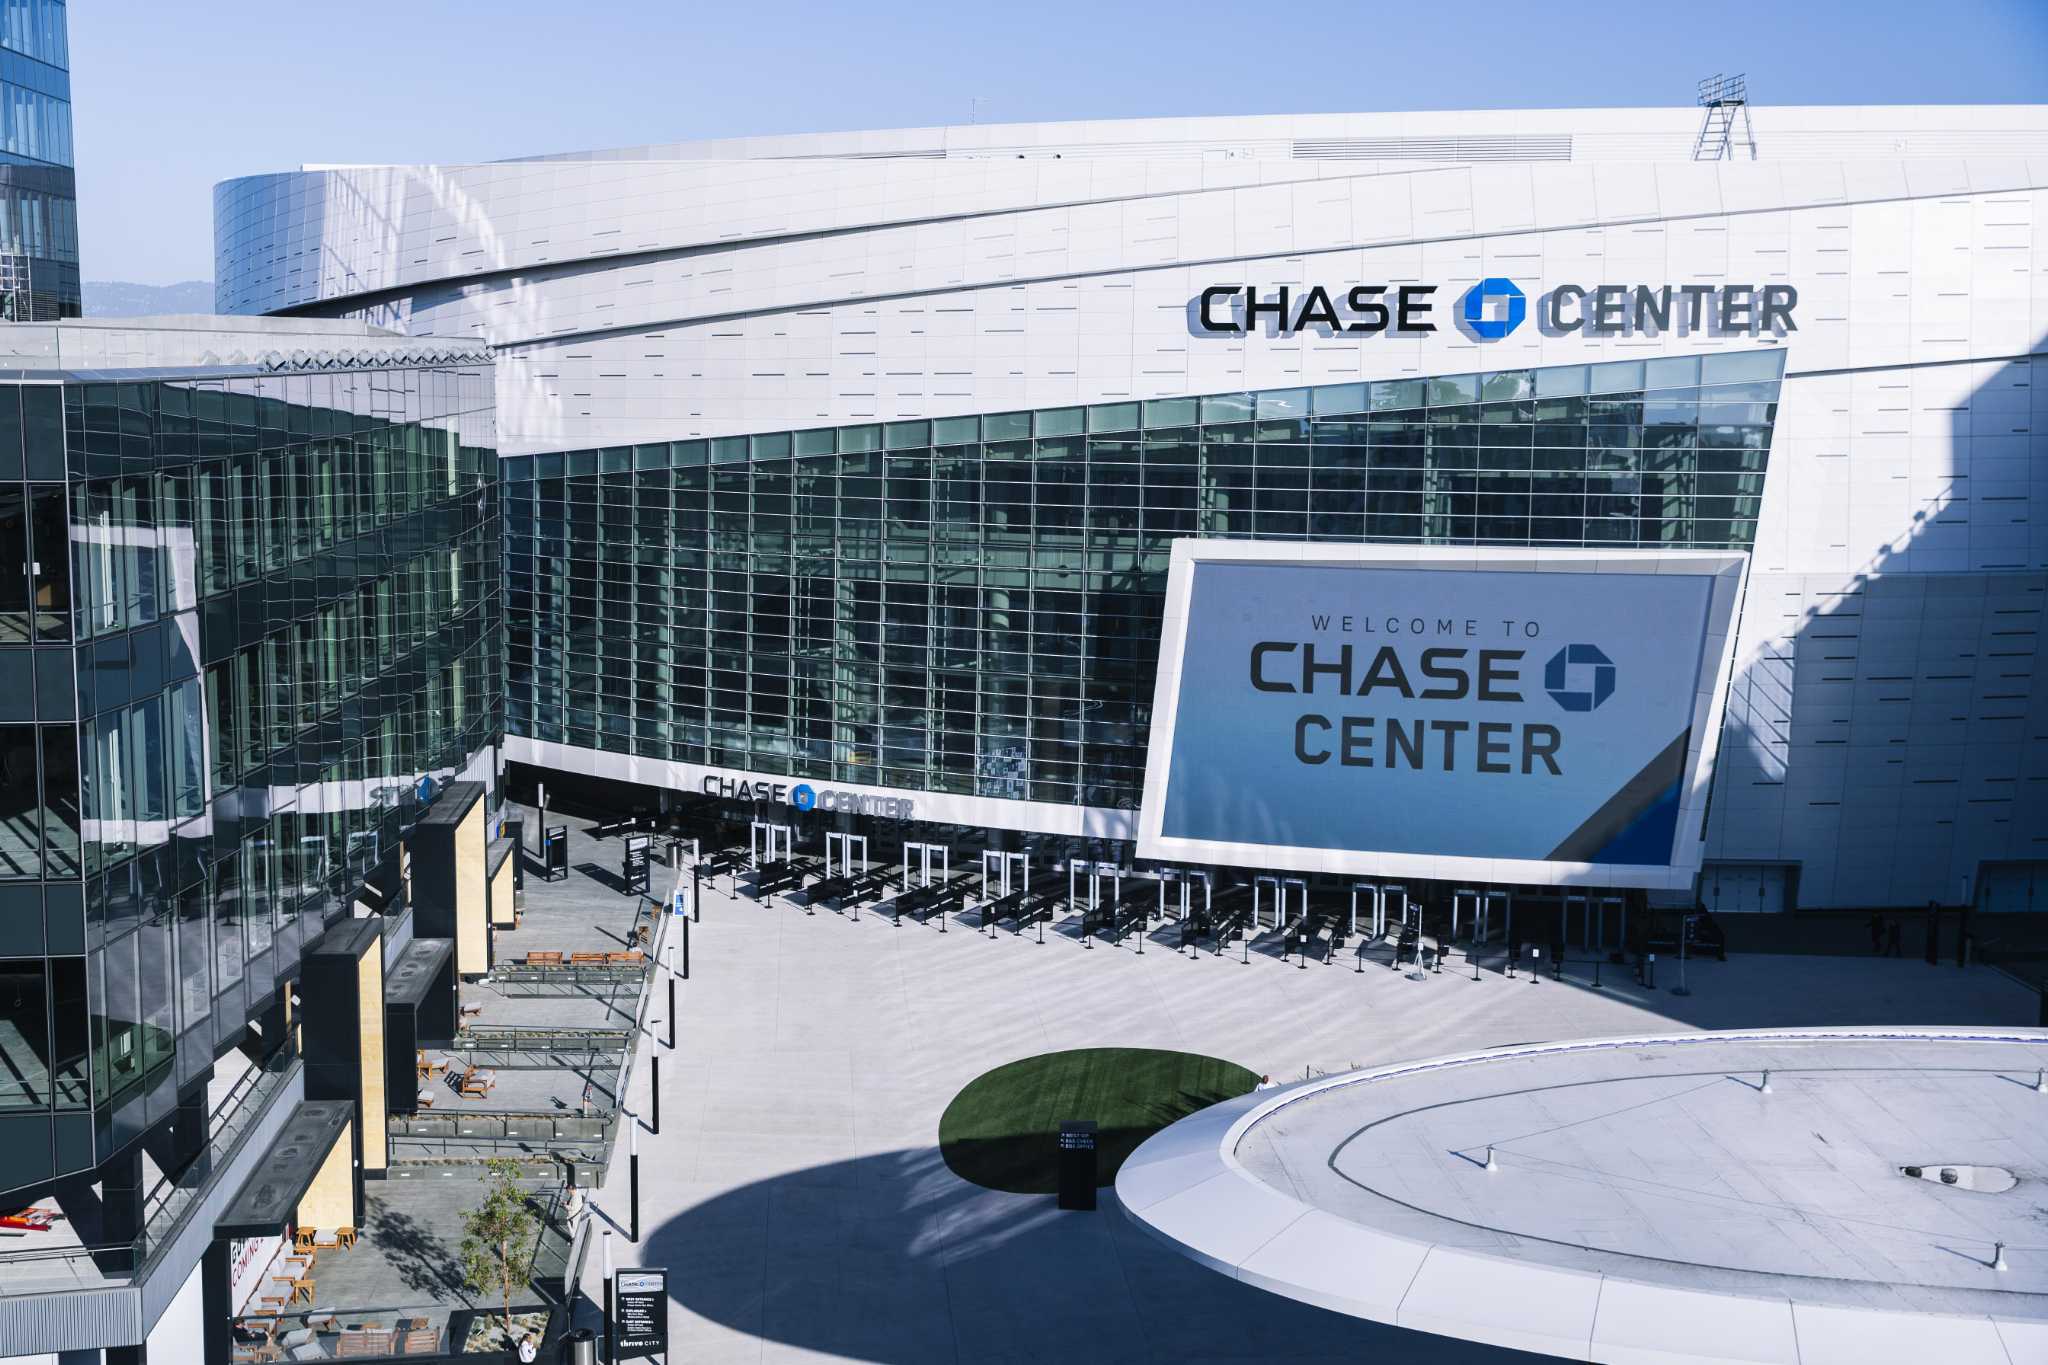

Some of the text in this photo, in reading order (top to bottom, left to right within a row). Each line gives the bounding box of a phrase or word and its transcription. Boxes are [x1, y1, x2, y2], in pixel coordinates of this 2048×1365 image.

[1200, 284, 1799, 332] CHASE CENTER
[1312, 614, 1541, 638] WELCOME TO
[1250, 641, 1526, 702] CHASE
[1295, 713, 1563, 776] CENTER
[703, 775, 914, 819] CHASE CENTER
[620, 1339, 643, 1347] thrive
